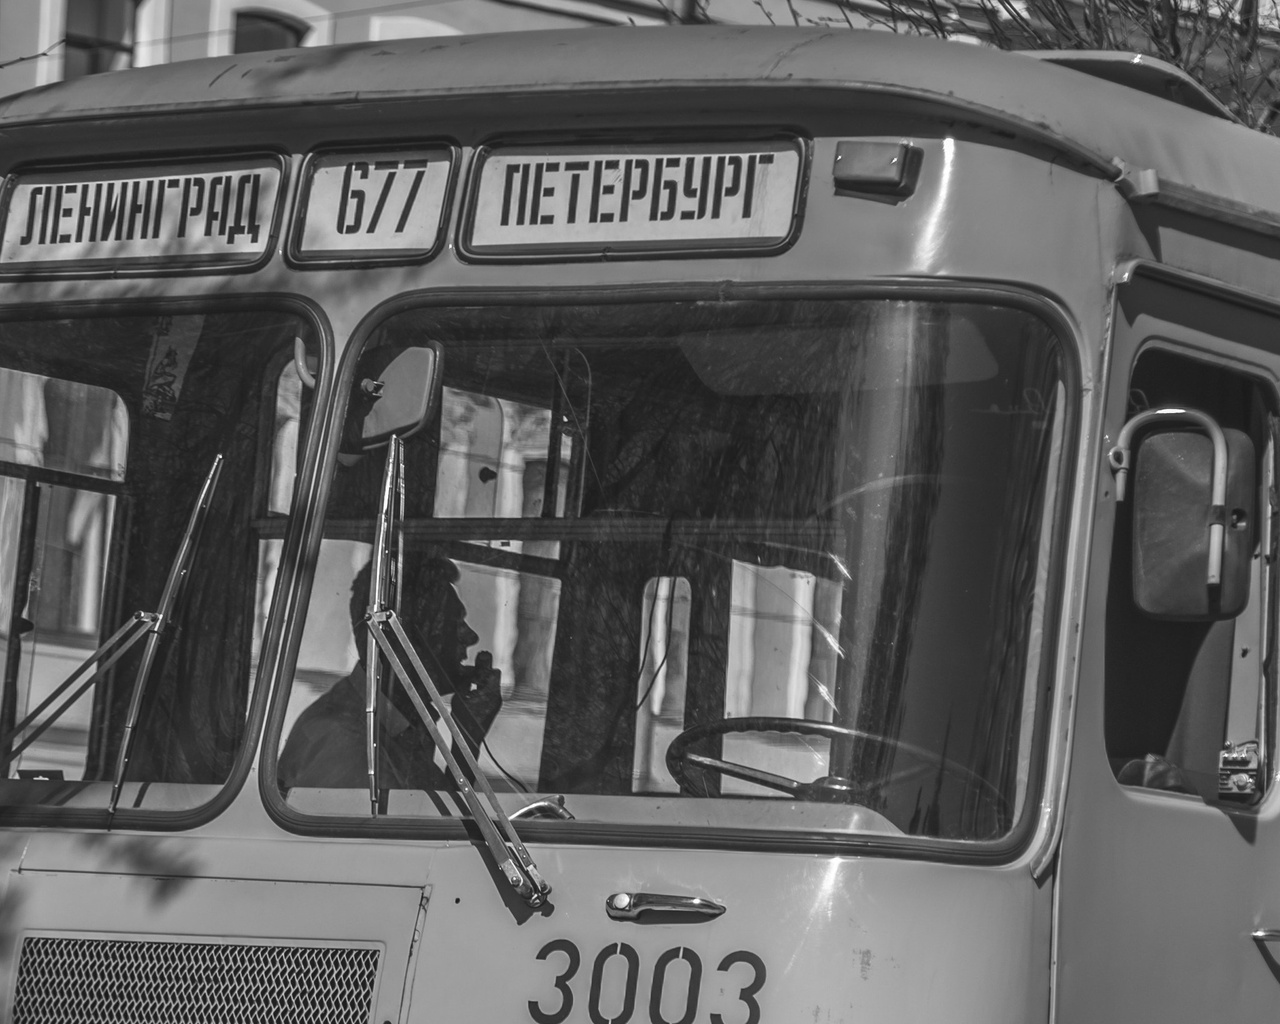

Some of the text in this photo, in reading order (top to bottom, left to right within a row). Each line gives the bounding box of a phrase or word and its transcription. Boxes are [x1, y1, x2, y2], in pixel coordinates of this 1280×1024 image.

[20, 173, 261, 246] ЛЕНИНГРАД
[336, 158, 428, 235] 677
[500, 154, 775, 226] ПЕТЕРБУРГ
